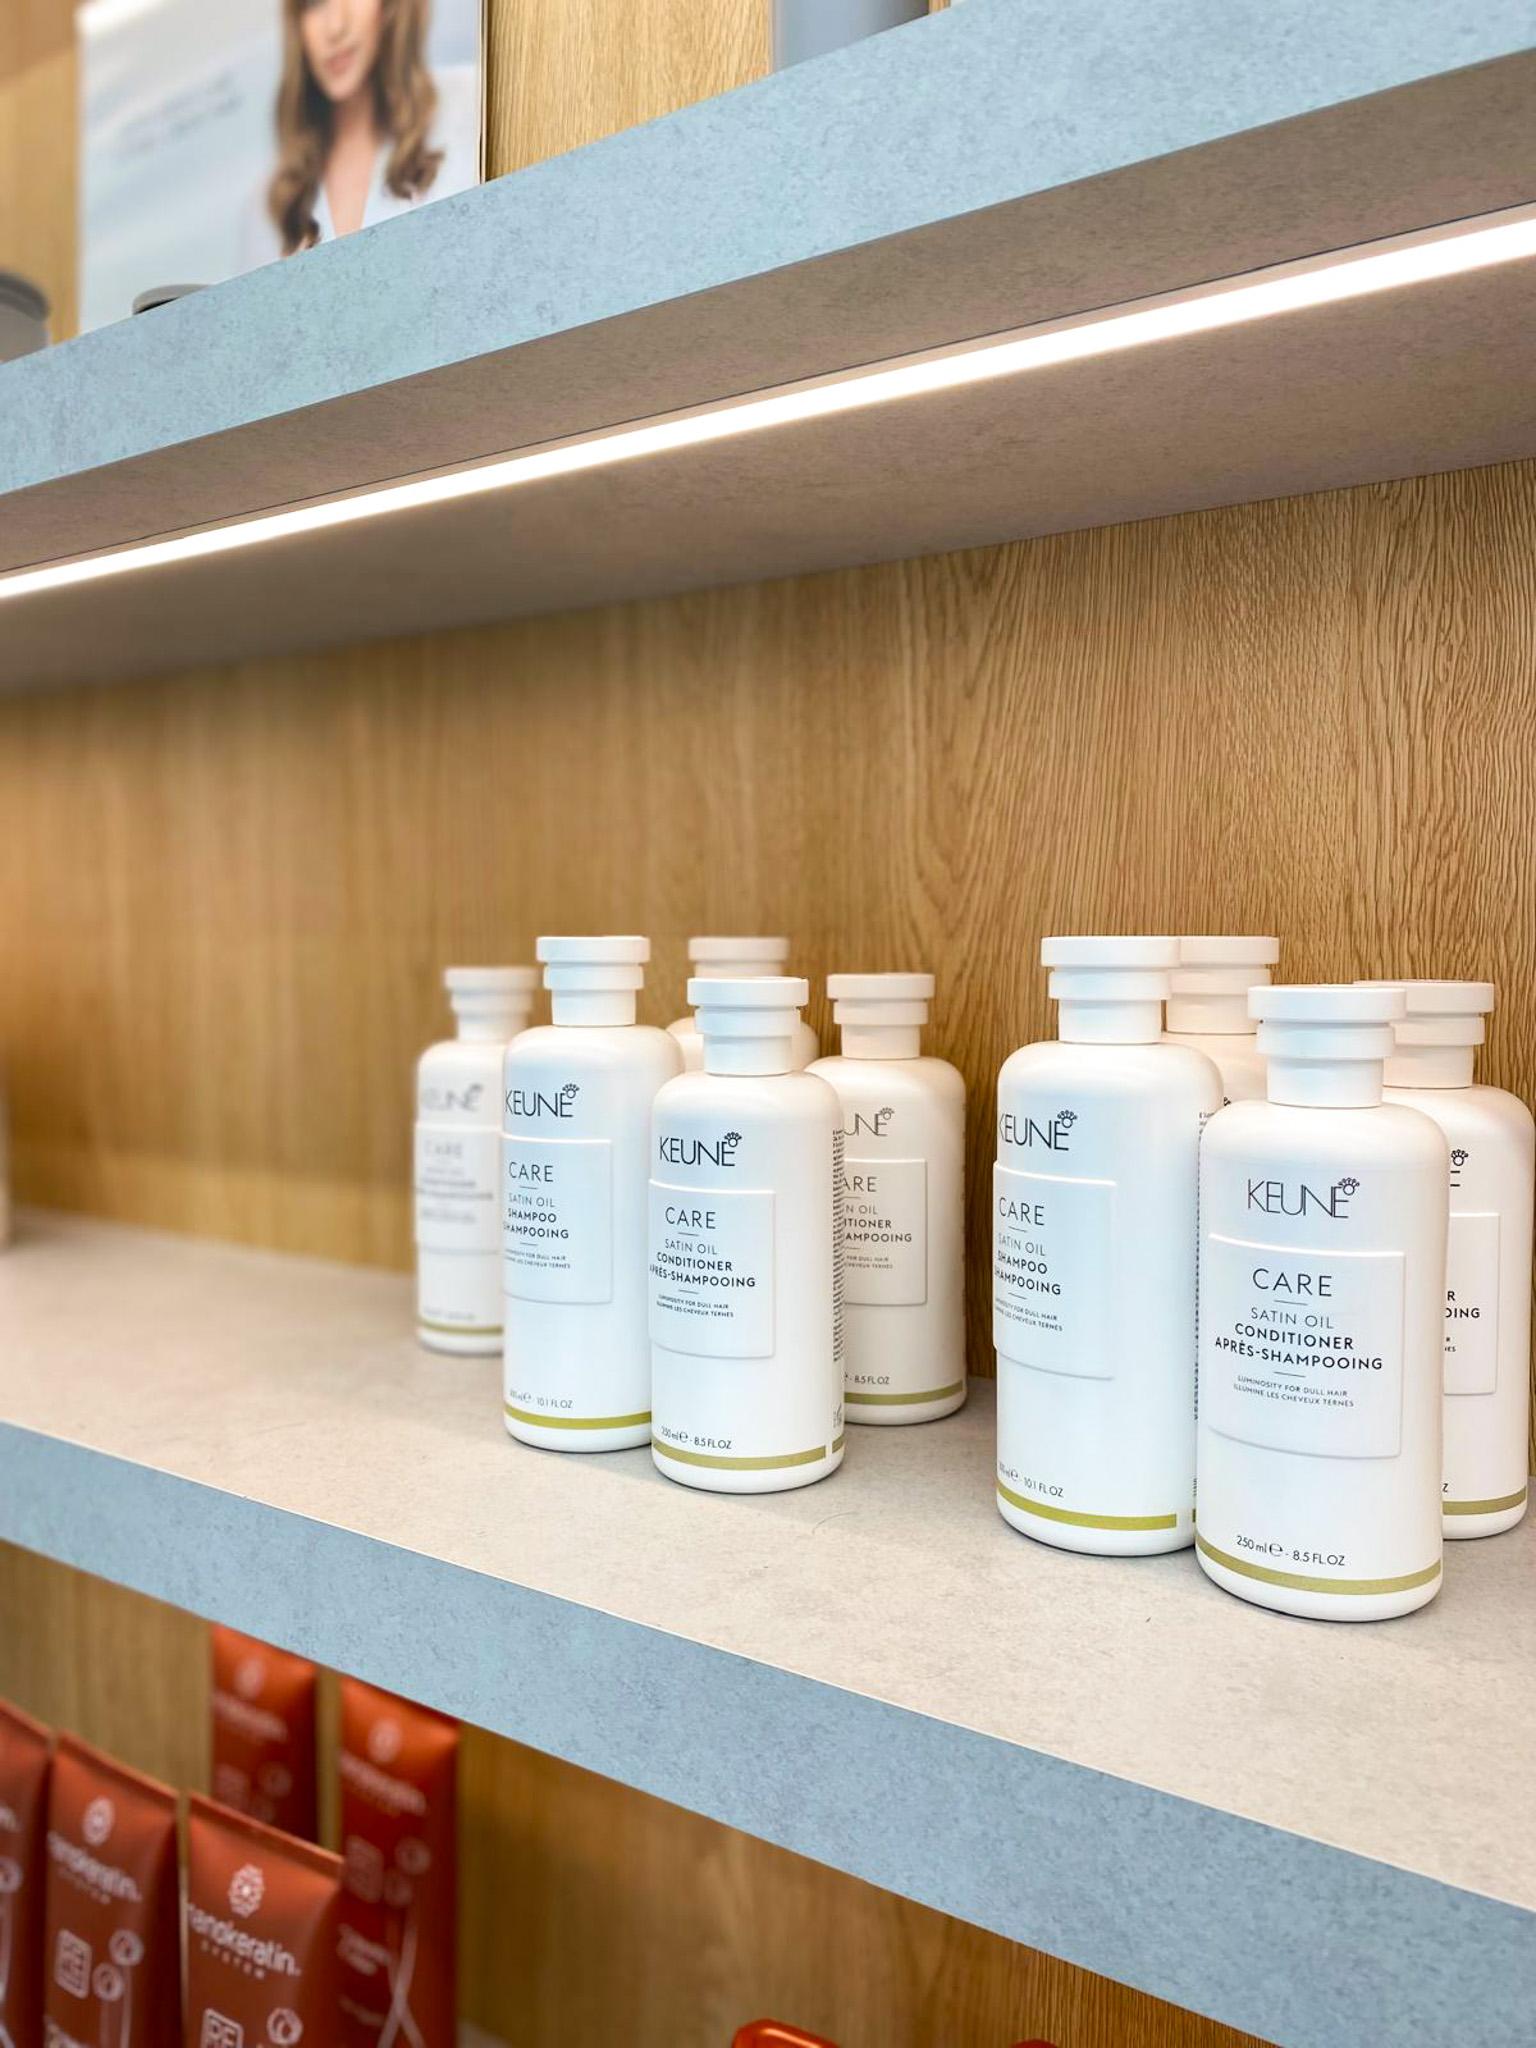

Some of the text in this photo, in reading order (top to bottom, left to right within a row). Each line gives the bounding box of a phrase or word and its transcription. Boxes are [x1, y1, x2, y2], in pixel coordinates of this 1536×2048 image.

[505, 1088, 574, 1118] KEUNE
[843, 1112, 887, 1136] UNE
[660, 1136, 736, 1167] KEUNE
[509, 1161, 554, 1183] CARE
[841, 1175, 877, 1193] ARE
[536, 1196, 555, 1208] OIL
[1248, 1178, 1349, 1219] KEUNE
[508, 1207, 557, 1223] SHAMPOO
[665, 1206, 716, 1230] CARE
[859, 1204, 878, 1215] OIL
[999, 1196, 1045, 1226] CARE
[844, 1218, 892, 1229] ITIONER
[665, 1239, 717, 1255] SATIN OIL
[845, 1232, 912, 1243] AMPOOING
[1025, 1242, 1046, 1257] OIL
[656, 1251, 734, 1272] CONDITIONER
[1252, 1268, 1332, 1297] CARE
[1251, 1307, 1334, 1329] SATIN OIL
[1234, 1322, 1354, 1350] CONDITIONER
[1237, 1375, 1282, 1389] LUMINOSITY
[1284, 1384, 1300, 1392] FOR
[1303, 1387, 1325, 1396] DULL
[1266, 1392, 1279, 1400] LES
[1281, 1394, 1320, 1405] CHEVEUX
[1322, 1400, 1354, 1408] TERNES
[1236, 1535, 1254, 1550] 250
[1293, 1550, 1310, 1563] 8.5
